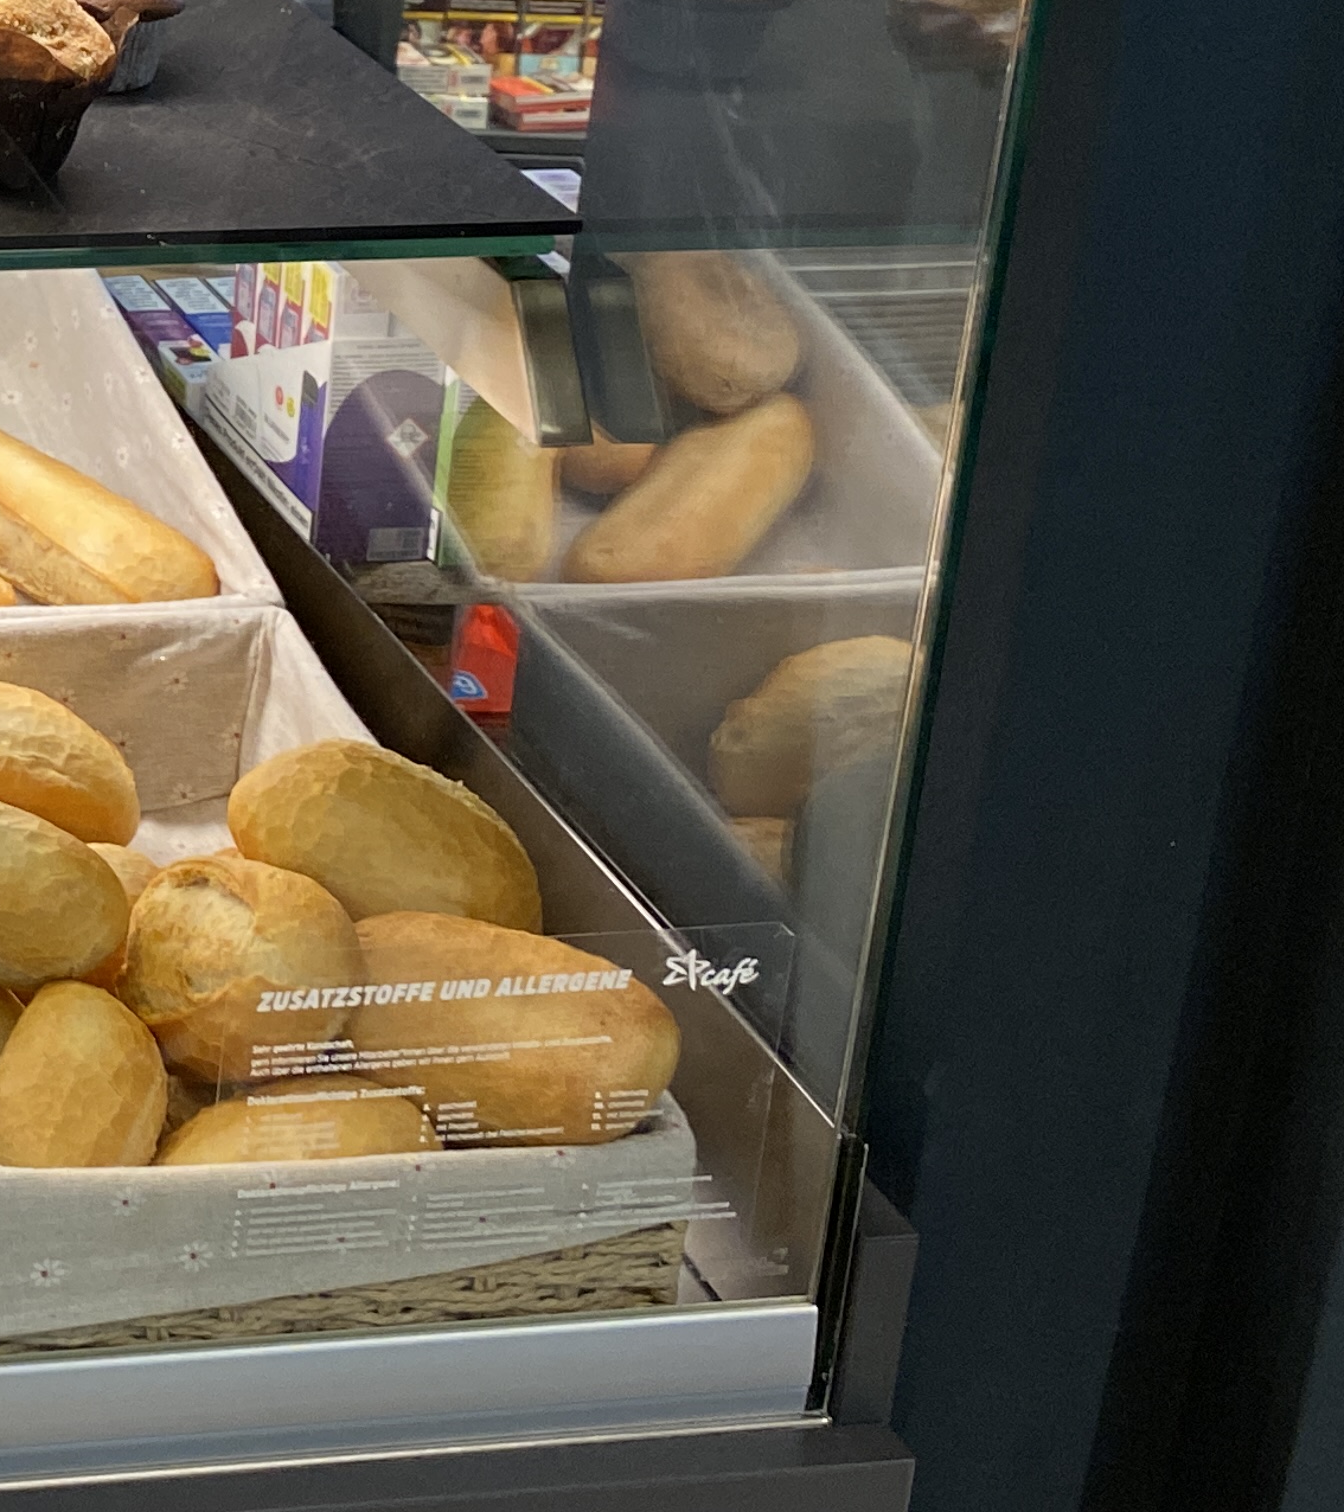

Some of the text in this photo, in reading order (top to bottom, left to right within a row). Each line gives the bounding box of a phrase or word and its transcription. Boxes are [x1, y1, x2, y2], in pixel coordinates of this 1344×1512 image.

[257, 969, 633, 1013] ZUSATZSTOFFE UND ALLERGENE
[700, 956, 760, 994] café
